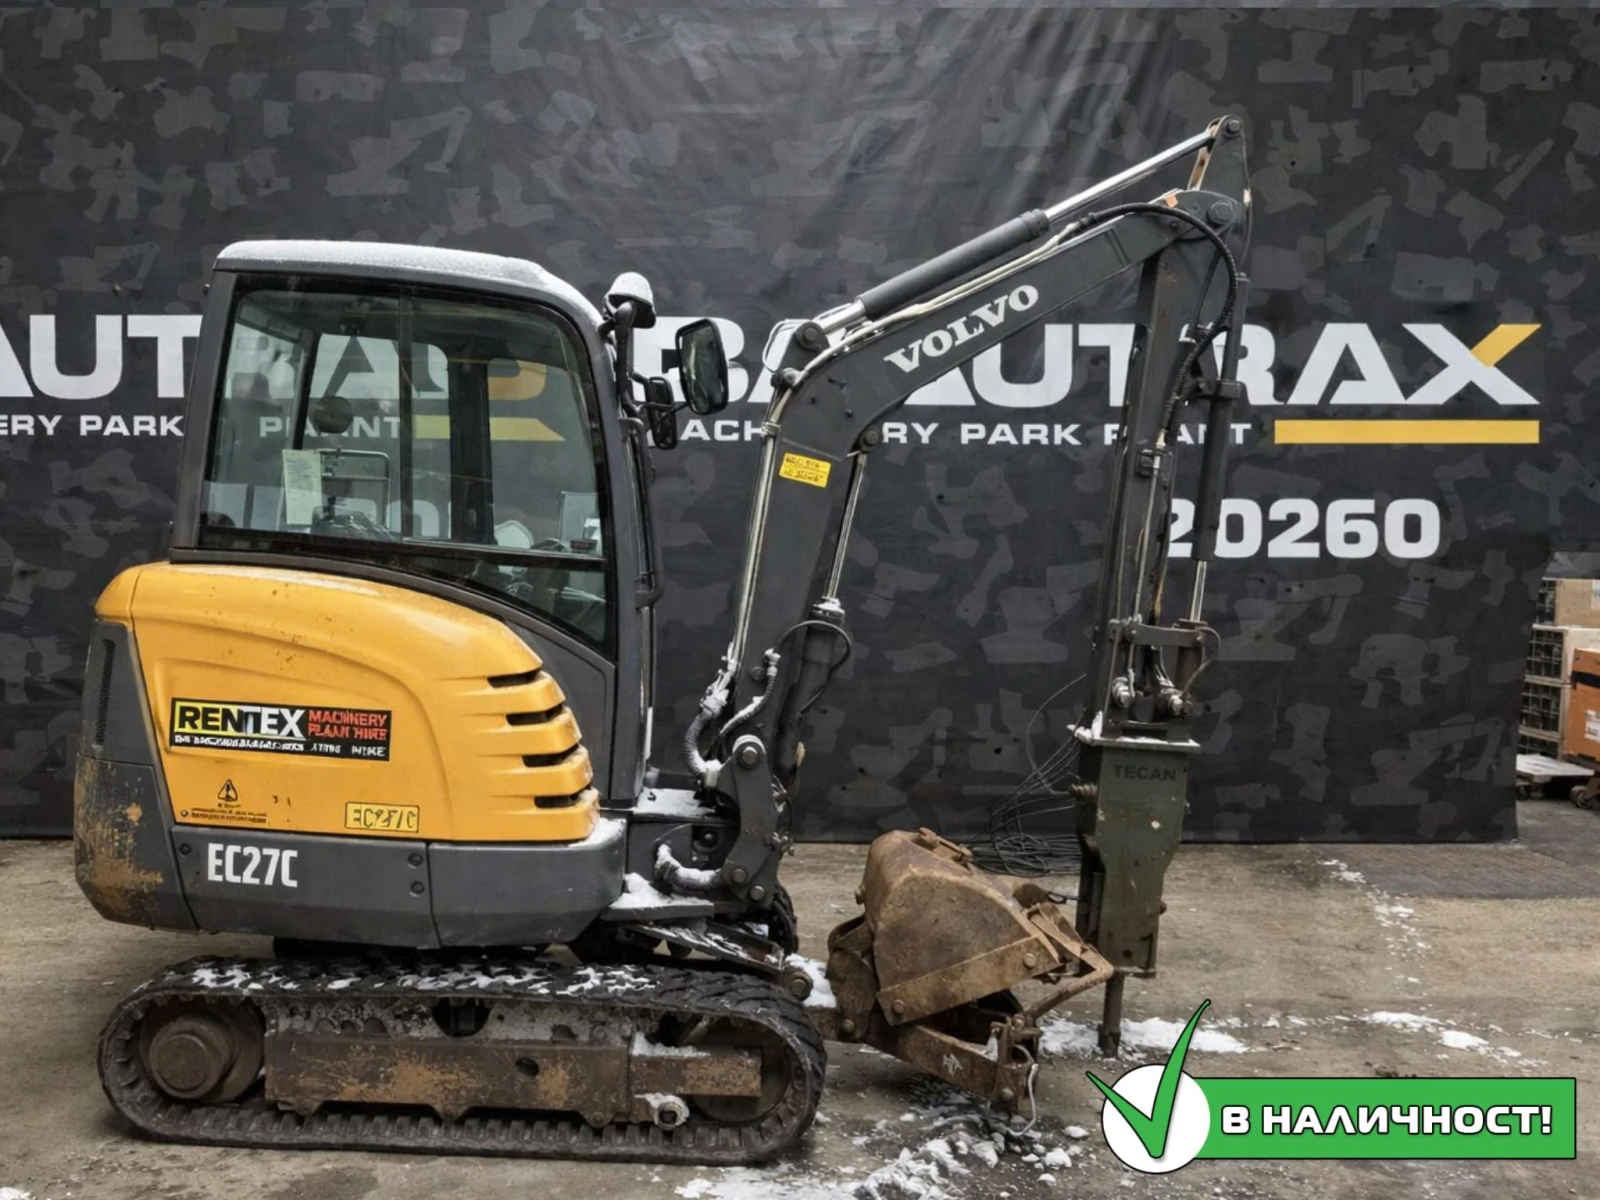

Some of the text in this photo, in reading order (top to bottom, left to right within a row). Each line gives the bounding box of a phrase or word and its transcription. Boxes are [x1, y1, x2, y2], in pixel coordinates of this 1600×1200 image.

[883, 284, 1039, 373] VOLVO
[80, 415, 184, 436] PARK
[960, 423, 1082, 445] PARK
[178, 704, 306, 741] RENTEX
[1113, 764, 1176, 781] TECAN
[207, 842, 298, 888] EC27C
